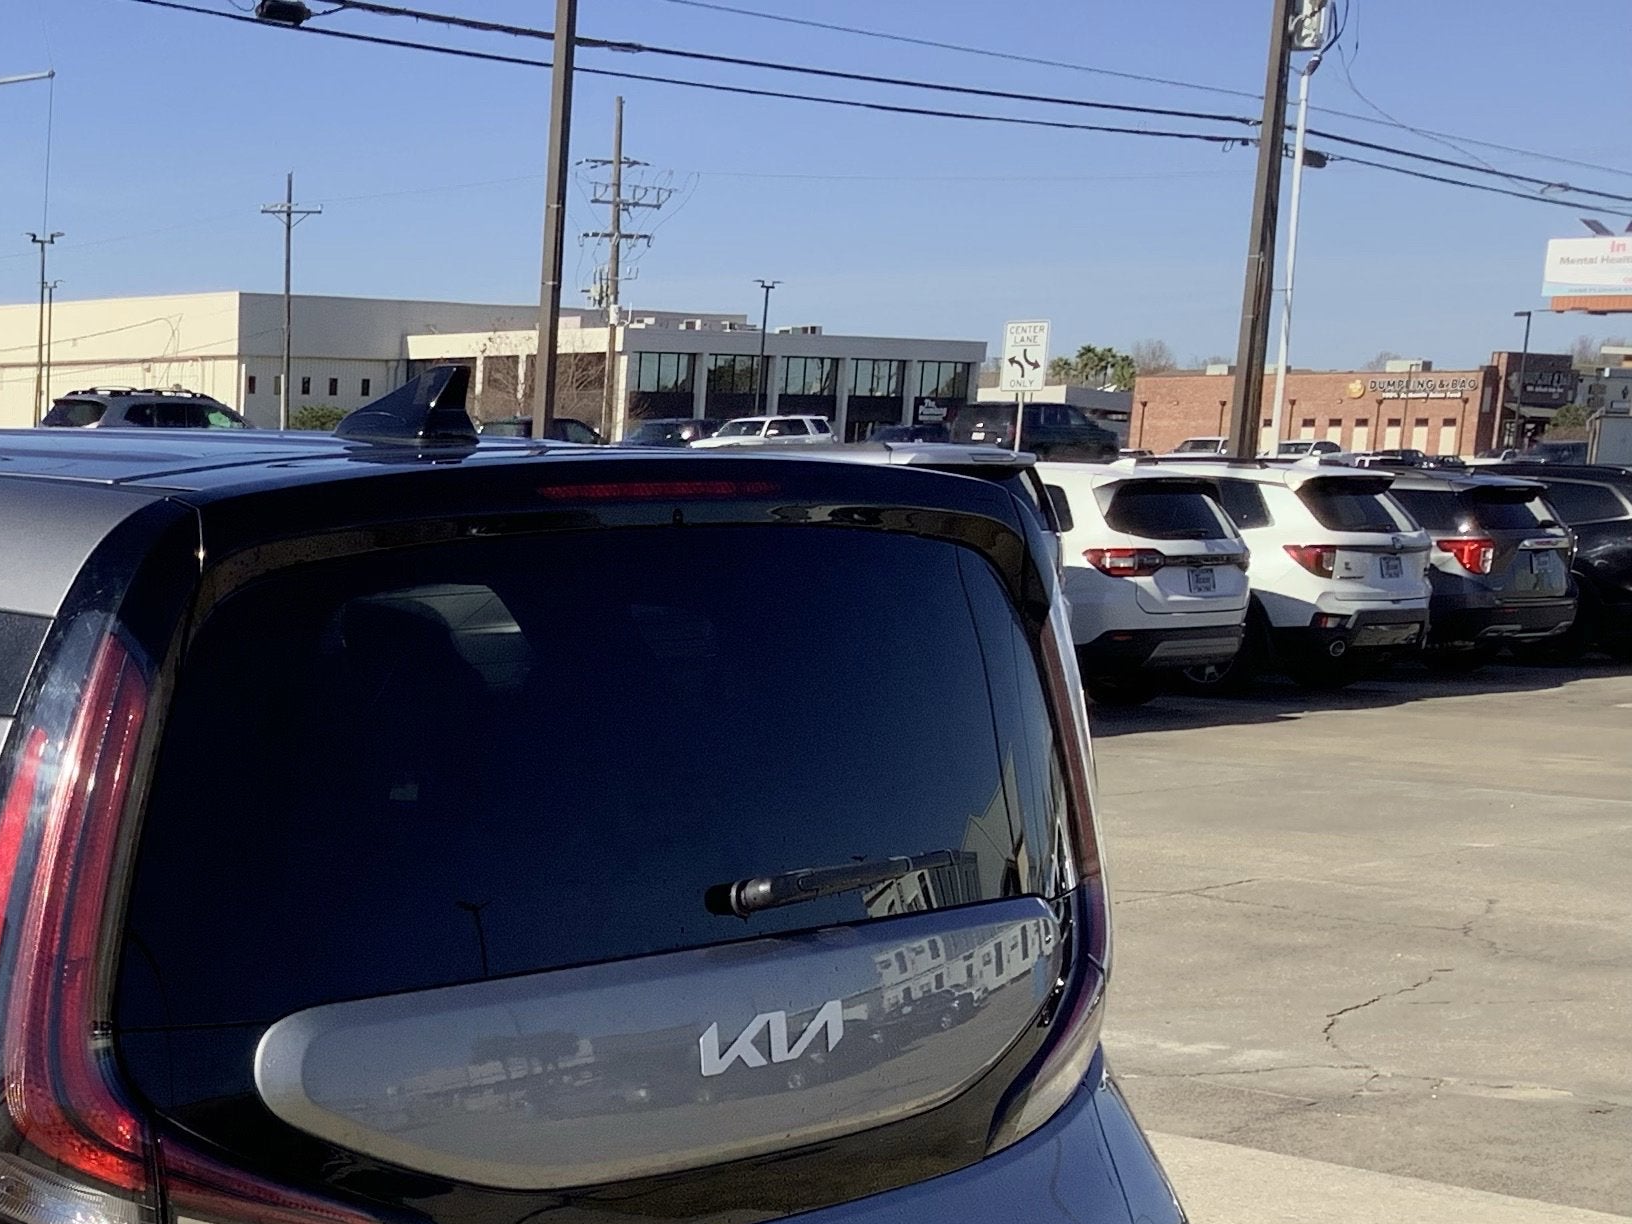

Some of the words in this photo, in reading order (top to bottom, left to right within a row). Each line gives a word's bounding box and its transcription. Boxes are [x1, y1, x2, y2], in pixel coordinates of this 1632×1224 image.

[1009, 325, 1045, 335] CENTER
[1013, 335, 1039, 344] LANE
[1009, 379, 1035, 388] ONLY
[1451, 379, 1478, 391] BAO
[699, 999, 844, 1078] KIA
